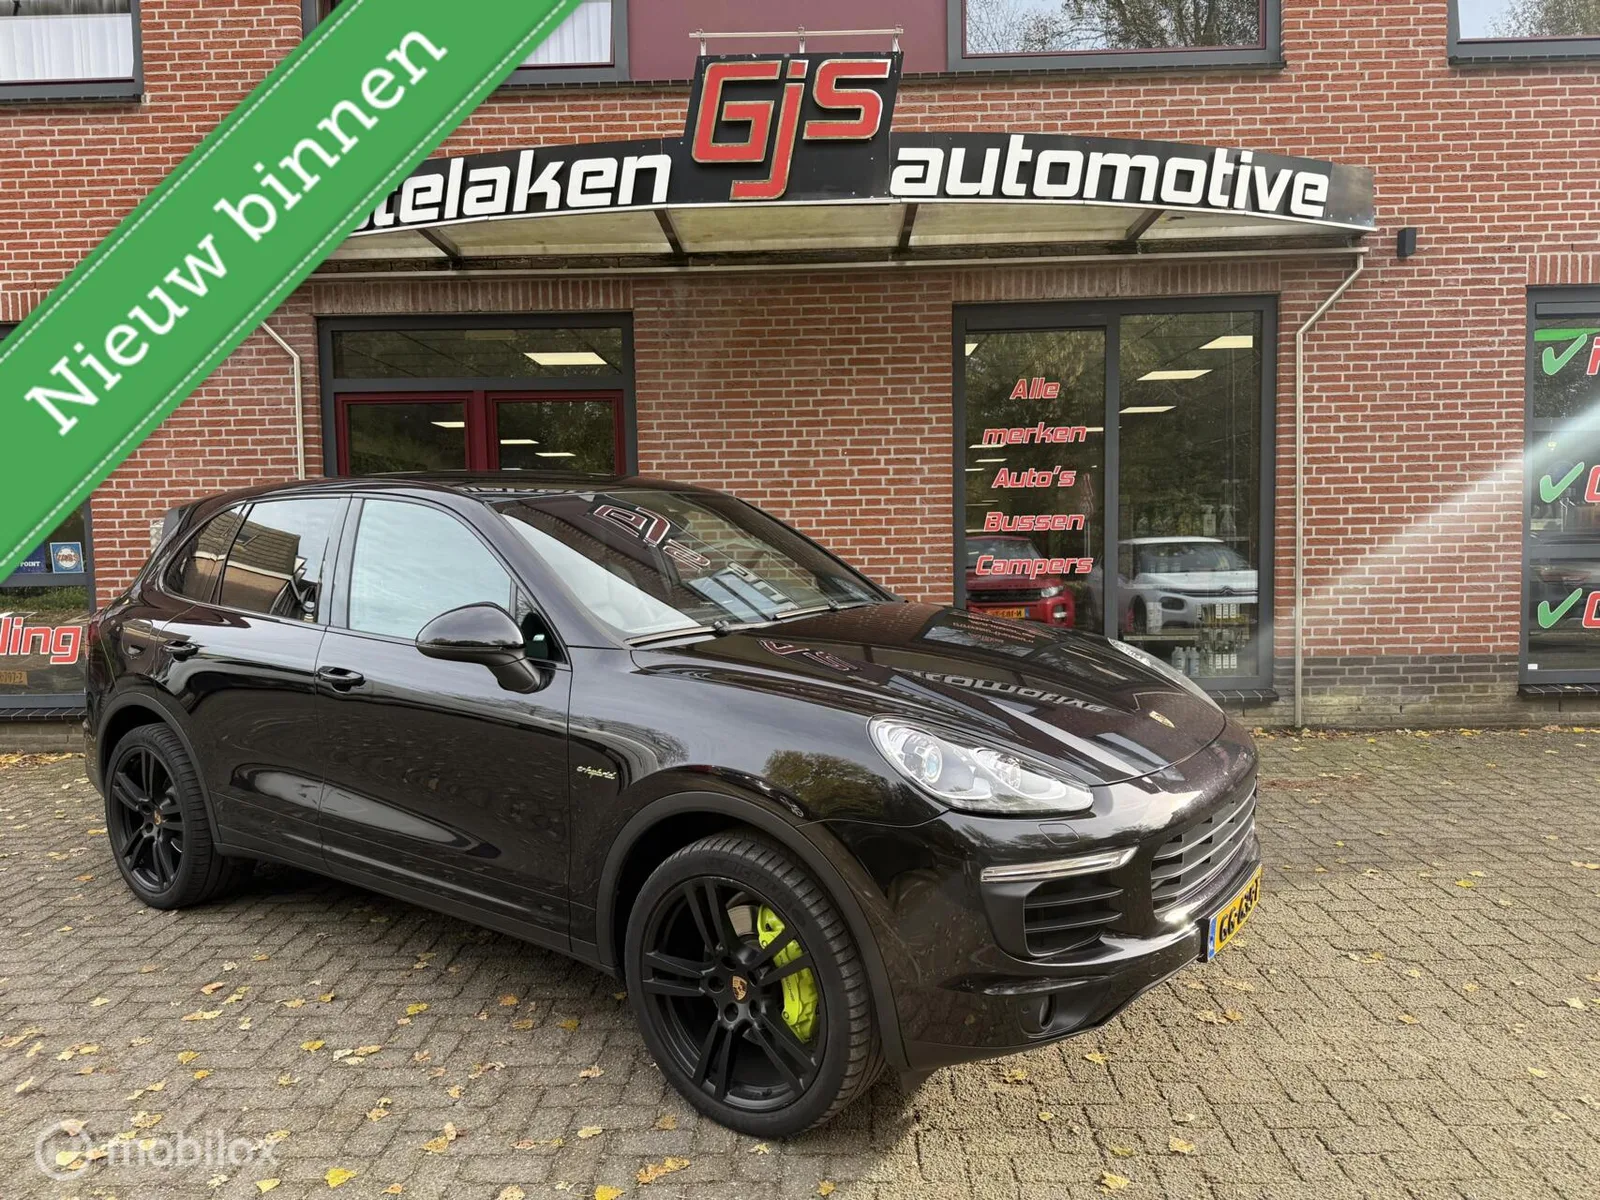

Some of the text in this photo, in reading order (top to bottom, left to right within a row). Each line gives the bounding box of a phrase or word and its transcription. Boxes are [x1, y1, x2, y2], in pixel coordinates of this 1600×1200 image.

[889, 132, 1330, 218] automotive
[1010, 377, 1060, 400] Alle
[982, 421, 1088, 446] merken
[991, 465, 1077, 489] Auto's
[983, 510, 1086, 533] Bussen
[975, 554, 1094, 580] Campers
